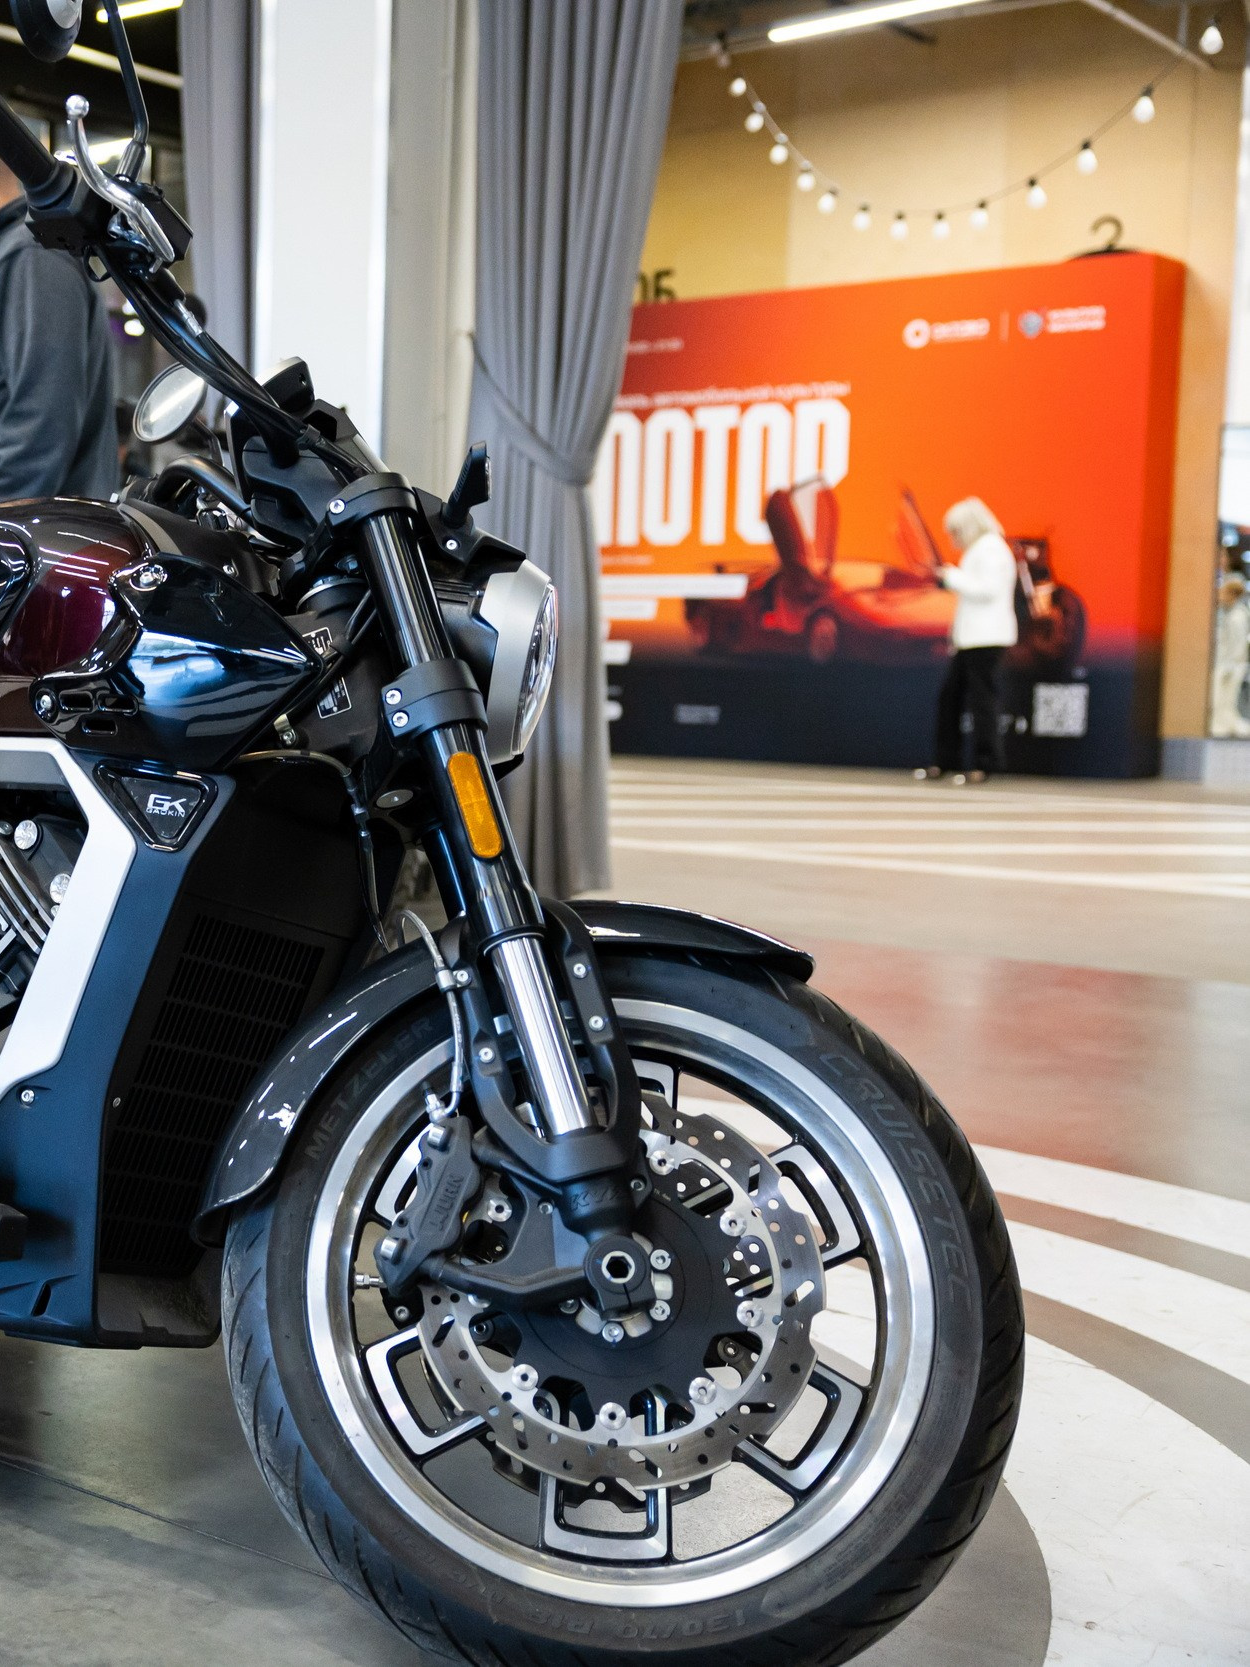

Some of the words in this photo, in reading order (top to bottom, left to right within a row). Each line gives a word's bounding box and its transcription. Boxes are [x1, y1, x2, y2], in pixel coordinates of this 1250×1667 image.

[145, 806, 186, 818] GAOKIN
[304, 1015, 435, 1161] METZELER
[818, 1052, 974, 1314] CRUISETEC
